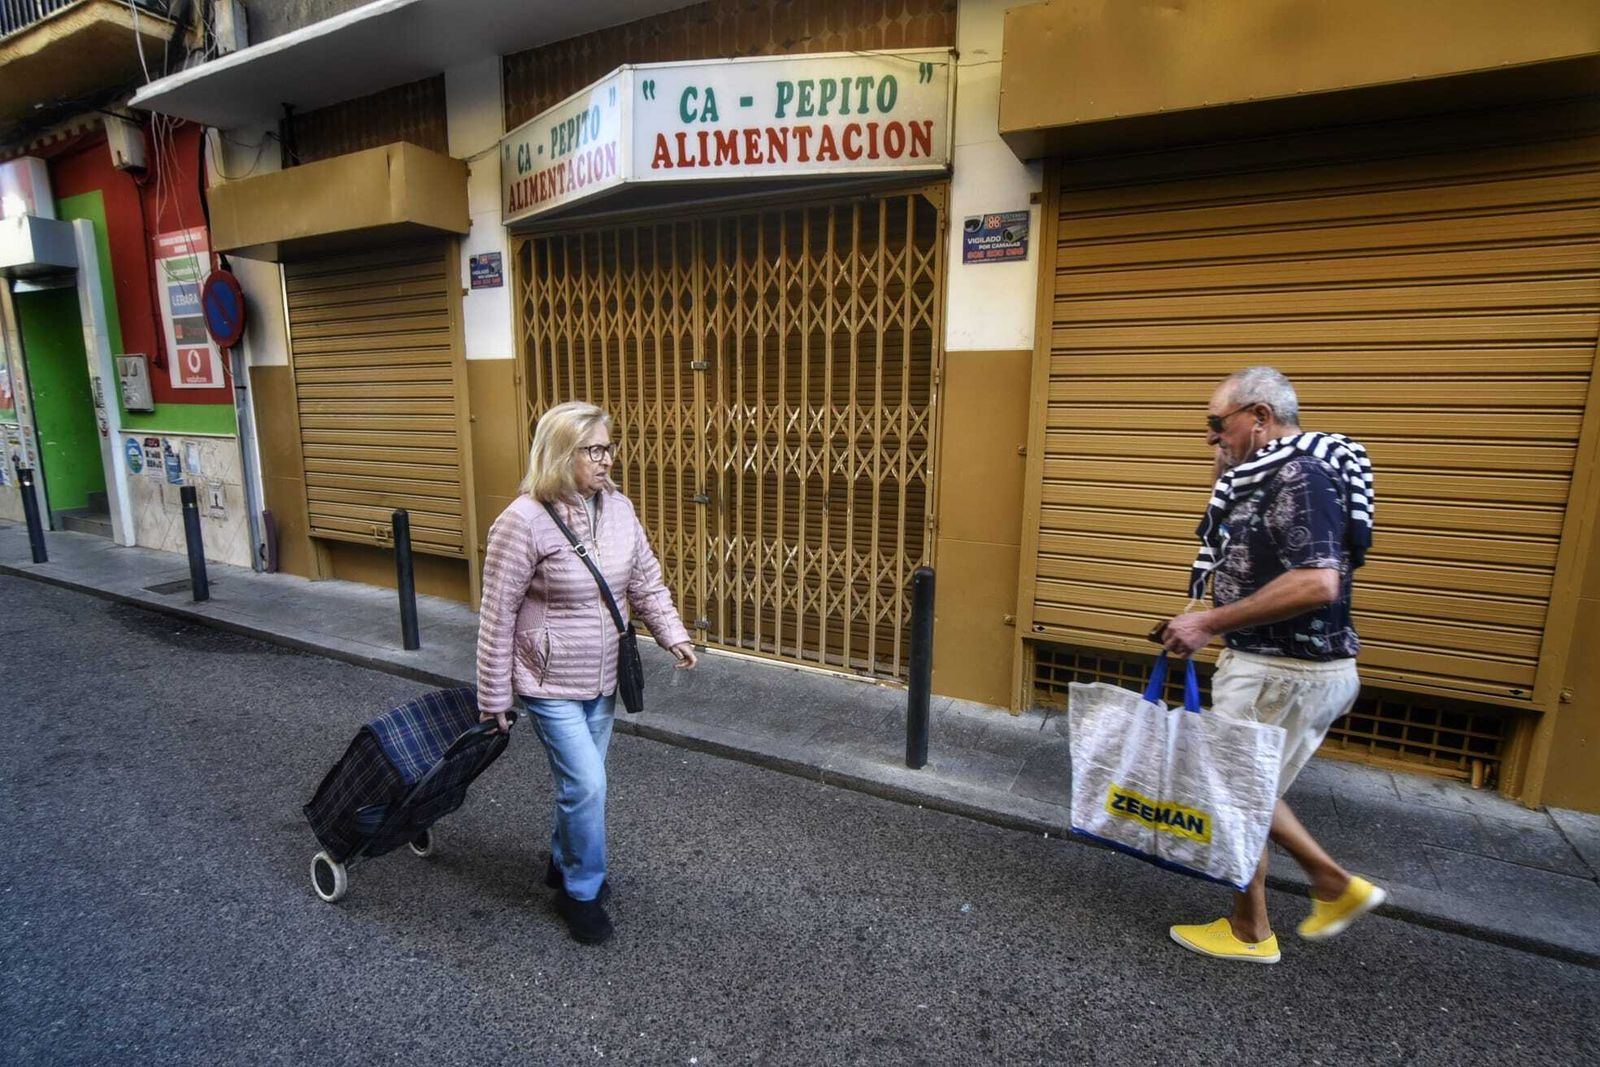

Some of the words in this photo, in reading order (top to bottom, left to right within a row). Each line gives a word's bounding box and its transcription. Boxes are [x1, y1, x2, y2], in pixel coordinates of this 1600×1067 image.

[679, 86, 720, 123] CA
[774, 74, 898, 119] PEPITO
[517, 142, 532, 175] CA
[550, 105, 601, 160] PEPITO
[651, 120, 934, 169] ALIMENTACION
[508, 141, 617, 214] ALIMENTACION
[967, 235, 1001, 244] VIGILADO
[171, 293, 200, 306] LEBARA
[1110, 792, 1204, 834] ZEEMAN
